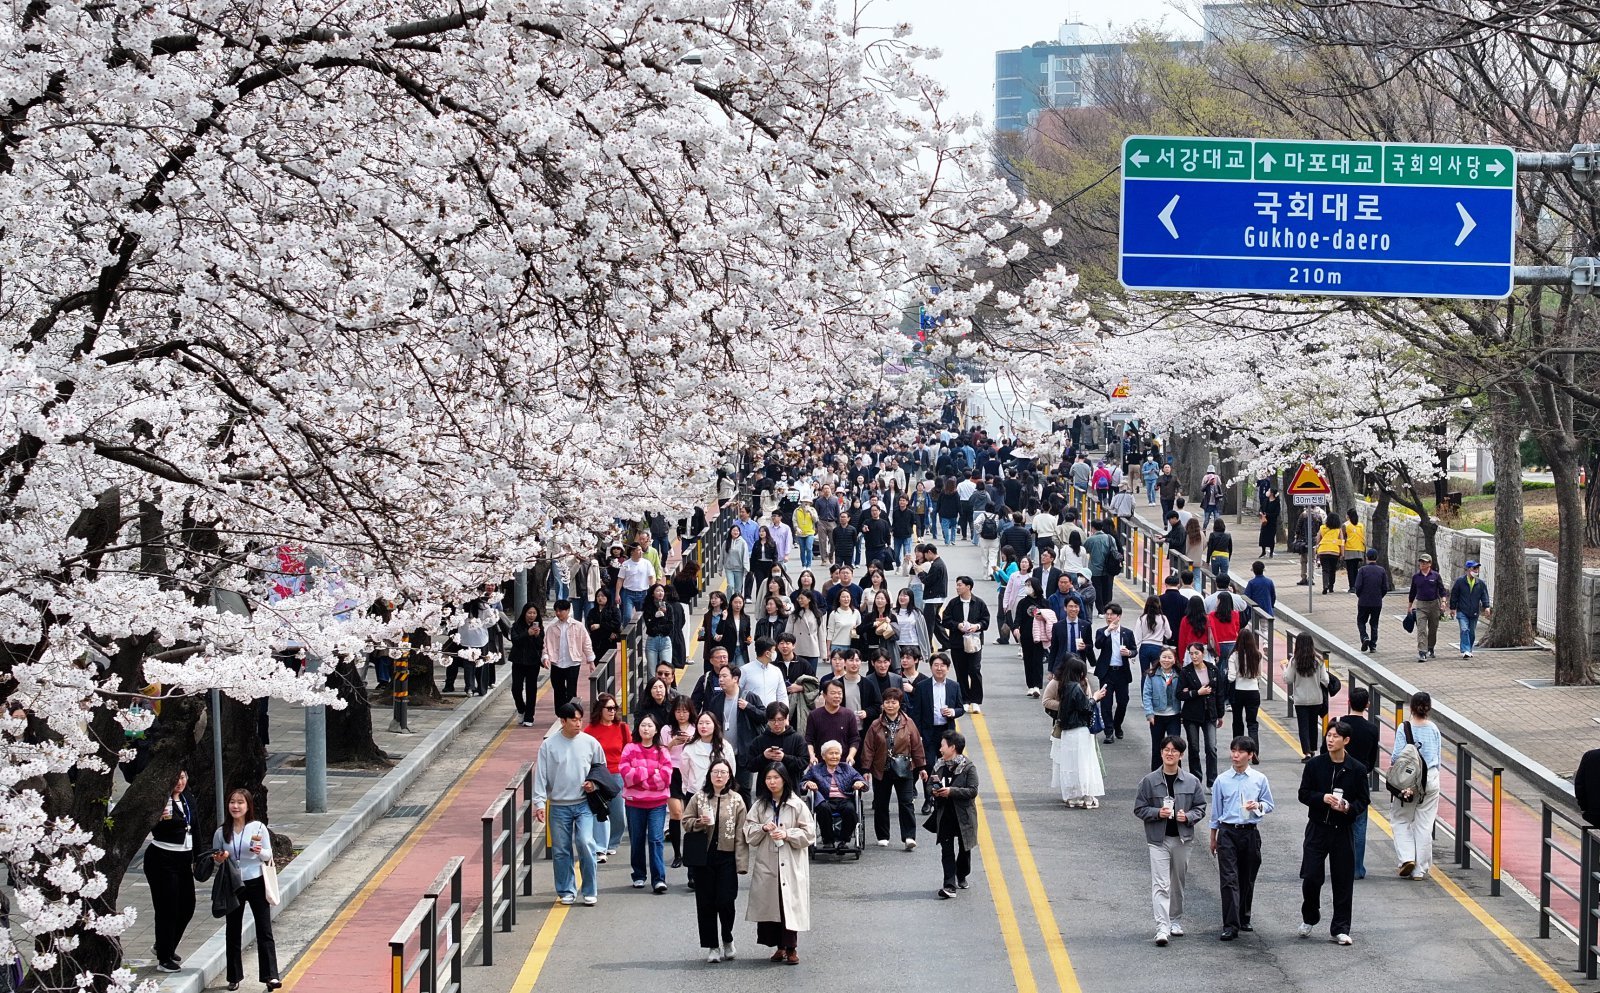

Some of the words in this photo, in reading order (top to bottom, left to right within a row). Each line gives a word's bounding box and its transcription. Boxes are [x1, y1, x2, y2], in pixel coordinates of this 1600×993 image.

[1156, 147, 1245, 172] 서강대교
[1284, 152, 1374, 175] 마포대교
[1391, 153, 1481, 180] 국회의사당
[1253, 191, 1383, 223] 국회대로
[1244, 226, 1390, 251] Gukhoe-daero
[1289, 267, 1342, 285] 210m
[1295, 496, 1310, 504] 30m
